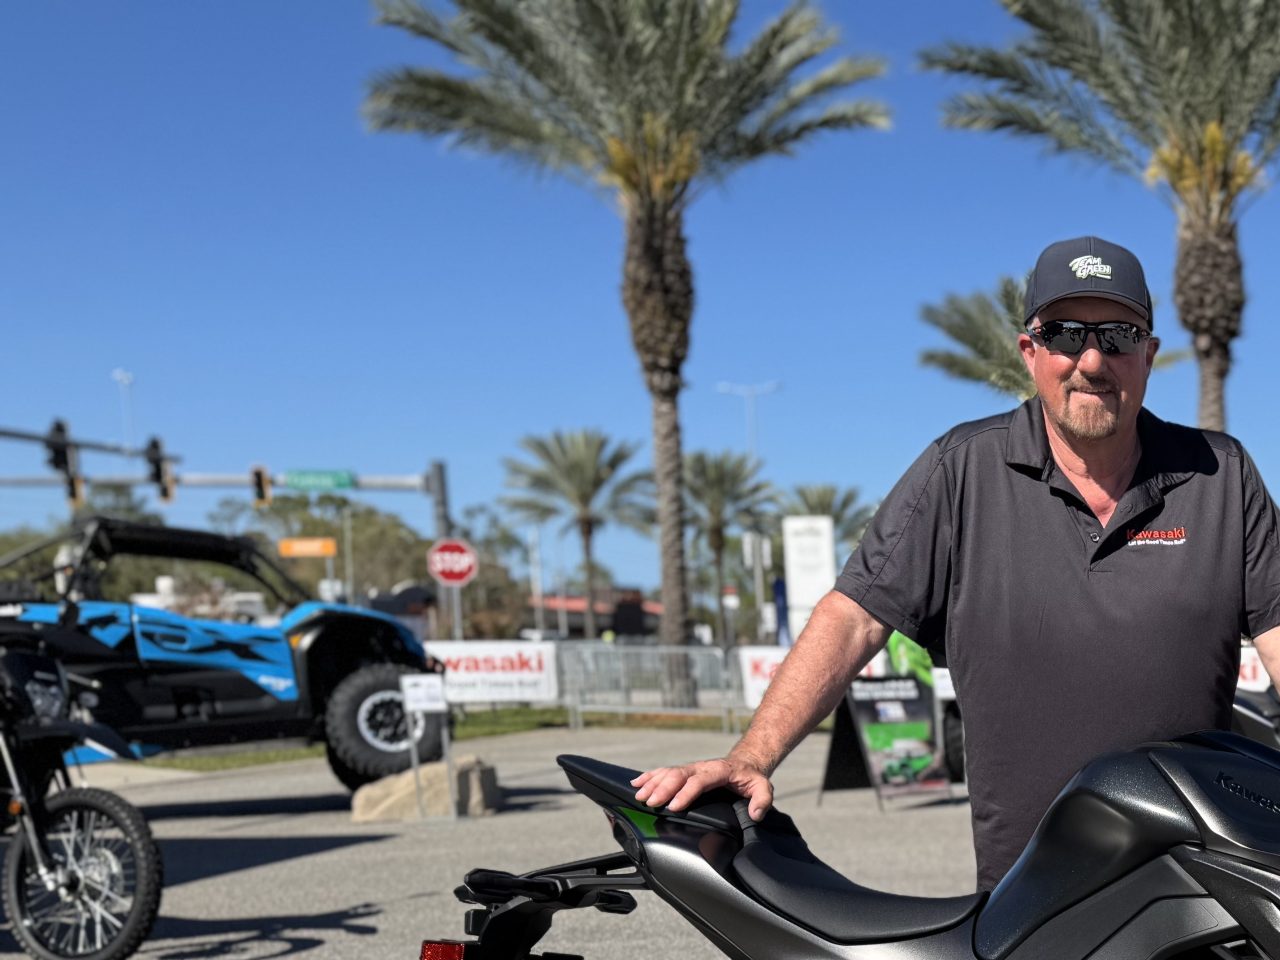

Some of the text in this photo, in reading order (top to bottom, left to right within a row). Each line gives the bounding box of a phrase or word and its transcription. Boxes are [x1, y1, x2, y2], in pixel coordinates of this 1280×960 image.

[1069, 255, 1102, 271] TEAM
[1076, 264, 1112, 279] GREEN
[1126, 527, 1185, 540] Kawasaki
[431, 552, 474, 572] STOP
[445, 652, 544, 673] wasaki
